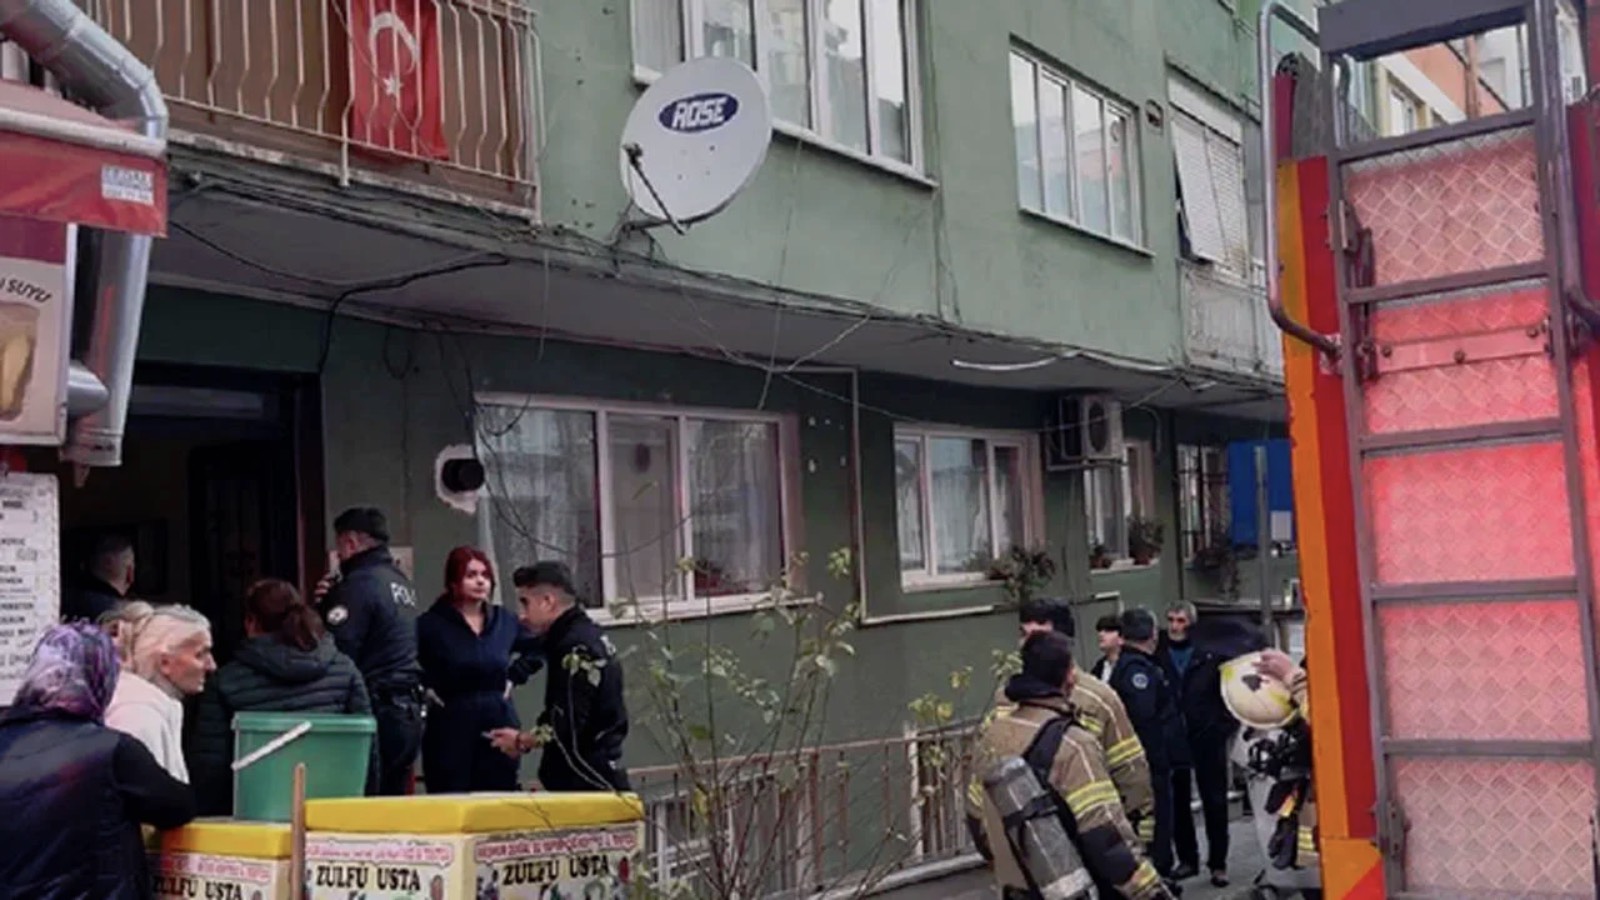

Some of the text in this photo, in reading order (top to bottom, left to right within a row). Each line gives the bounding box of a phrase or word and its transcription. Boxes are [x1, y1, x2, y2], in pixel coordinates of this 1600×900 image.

[671, 96, 728, 129] ROSE
[569, 854, 610, 879] USTA
[204, 880, 243, 900] USTA
[376, 867, 421, 891] USTA
